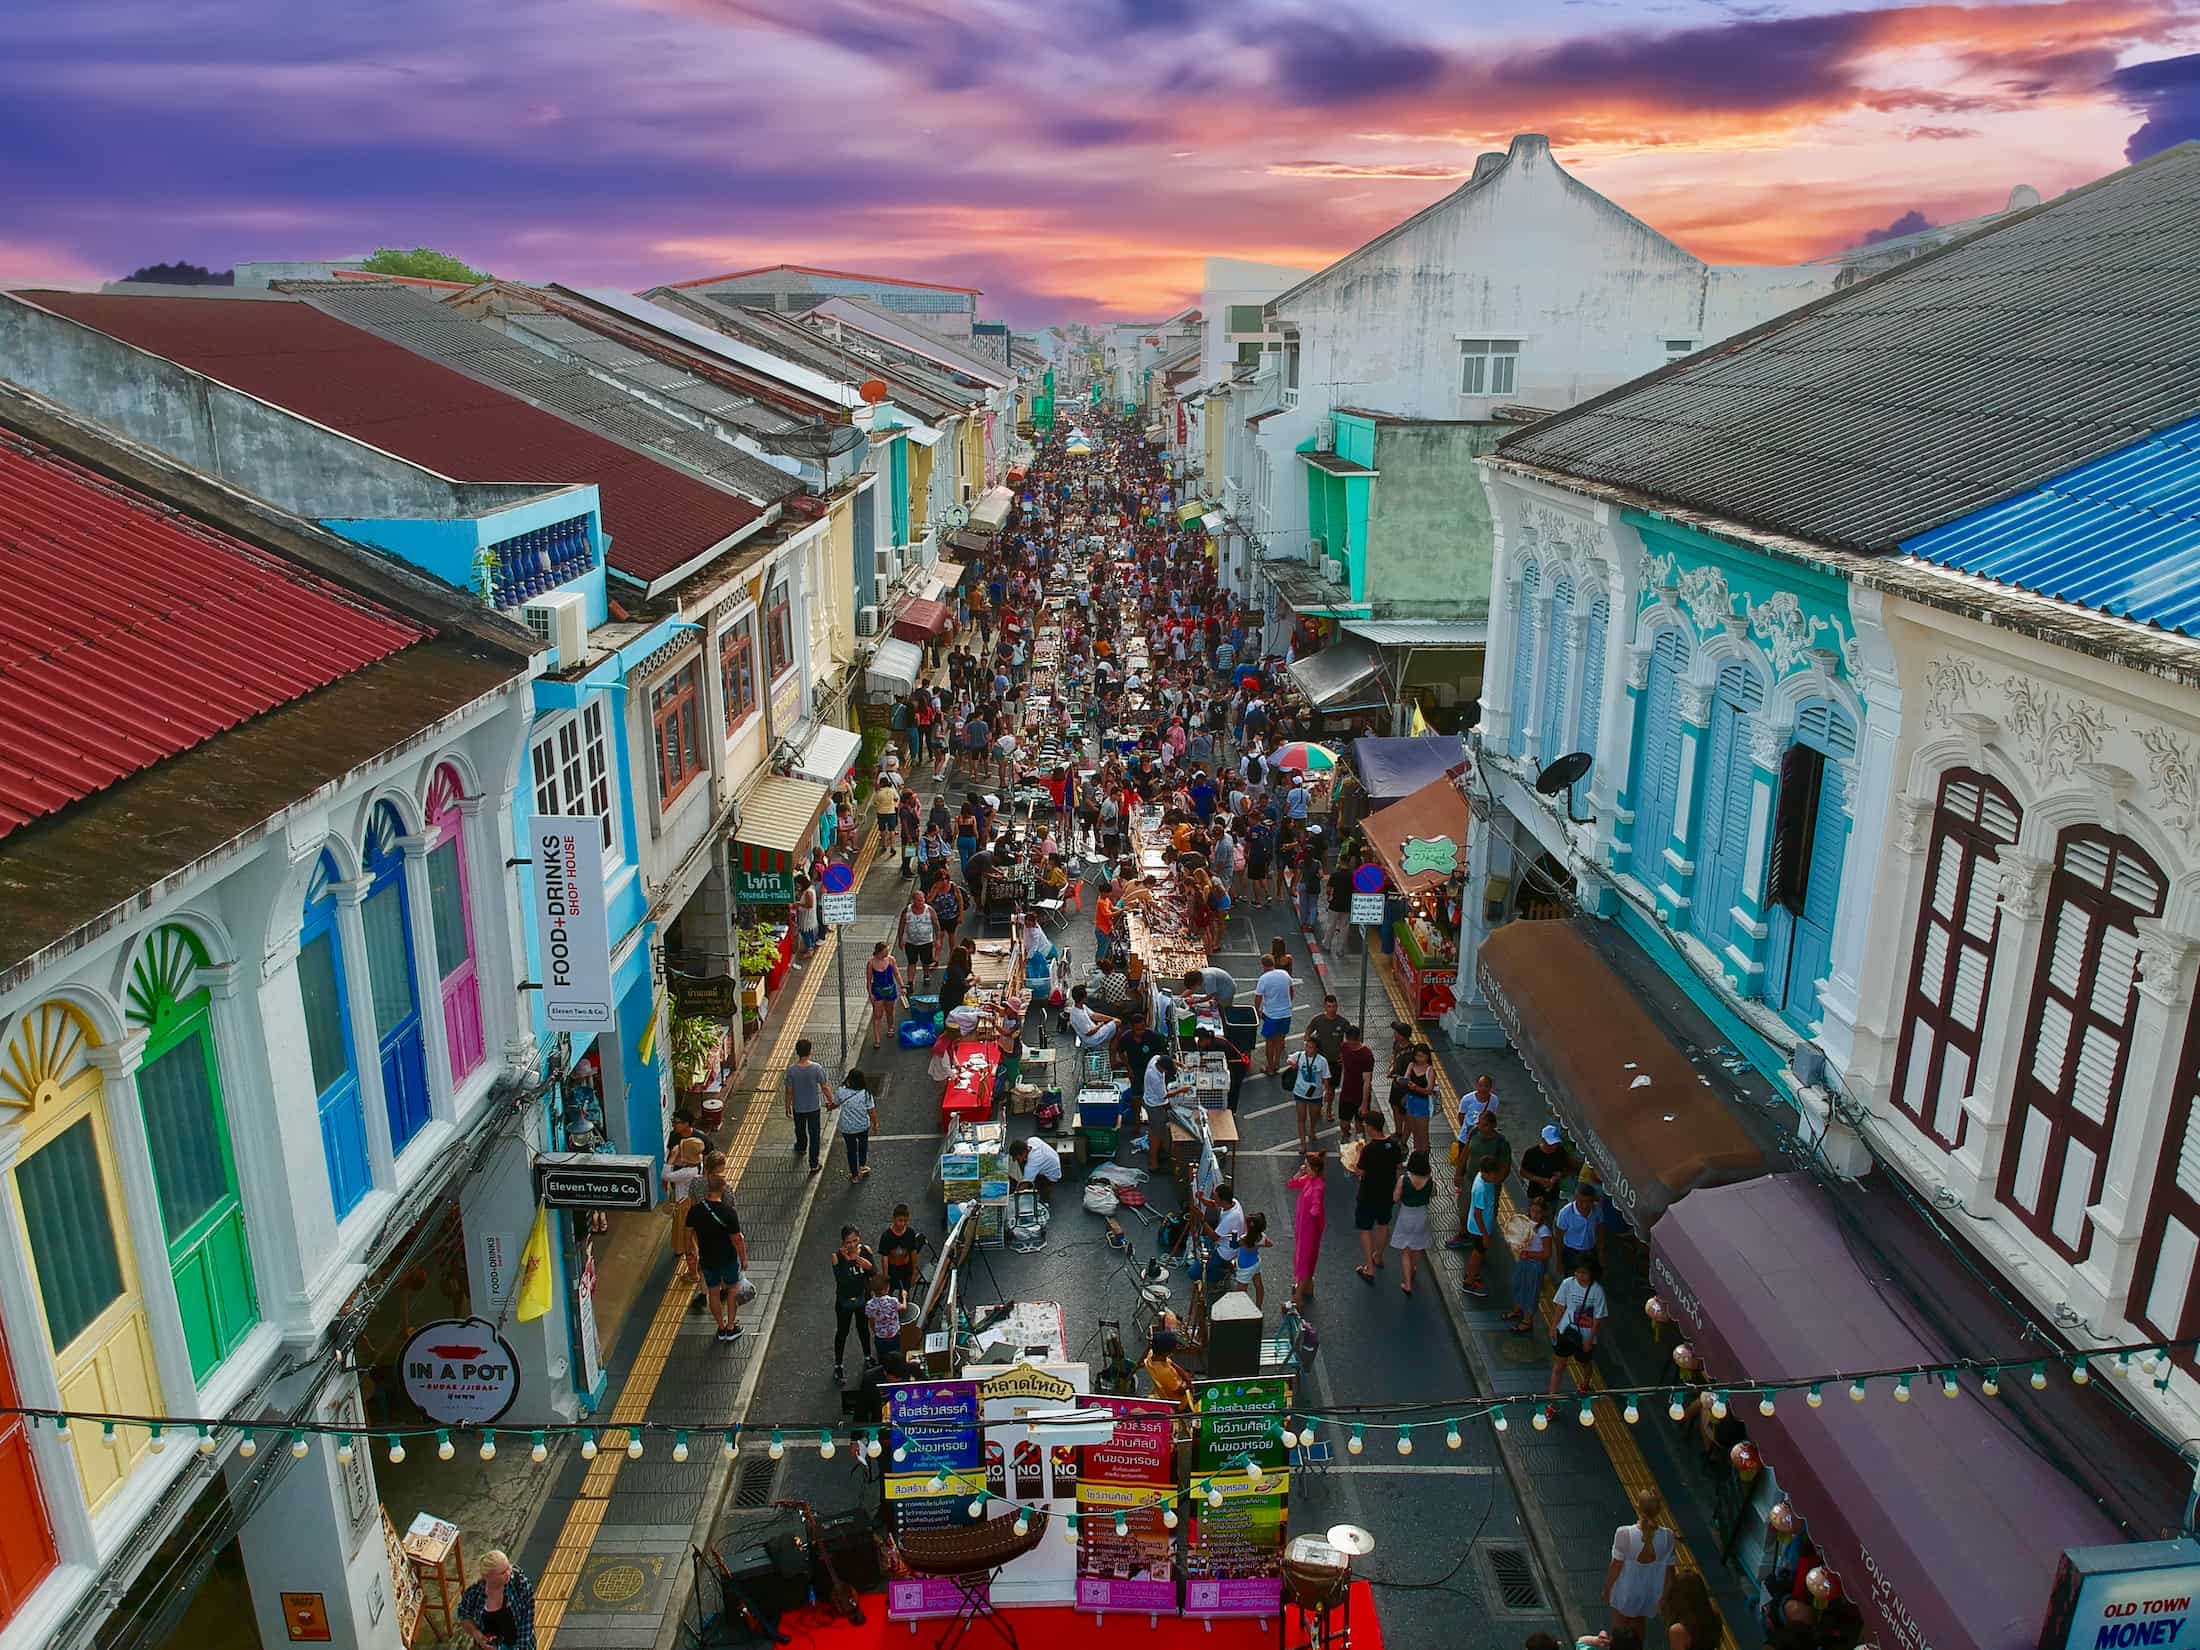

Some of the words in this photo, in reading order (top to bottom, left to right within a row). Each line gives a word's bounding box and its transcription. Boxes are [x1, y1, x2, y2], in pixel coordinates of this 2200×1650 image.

[563, 835, 577, 878] HOUSE
[567, 881, 580, 916] SHOP
[542, 834, 571, 987] FOOD+DRINKS
[551, 1007, 573, 1015] Eleven
[549, 1181, 585, 1192] Eleven
[586, 1183, 609, 1193] Two
[611, 1184, 619, 1193] &
[621, 1184, 639, 1194] Co.
[409, 1363, 433, 1379] IN
[440, 1363, 457, 1380] A
[463, 1363, 509, 1381] POT
[1017, 1464, 1041, 1476] NO
[1054, 1464, 1078, 1476] NO
[1860, 1543, 1891, 1599] TONG
[2103, 1602, 2138, 1618] OLD
[2142, 1597, 2191, 1615] TOWN
[2094, 1617, 2188, 1650] MONEY
